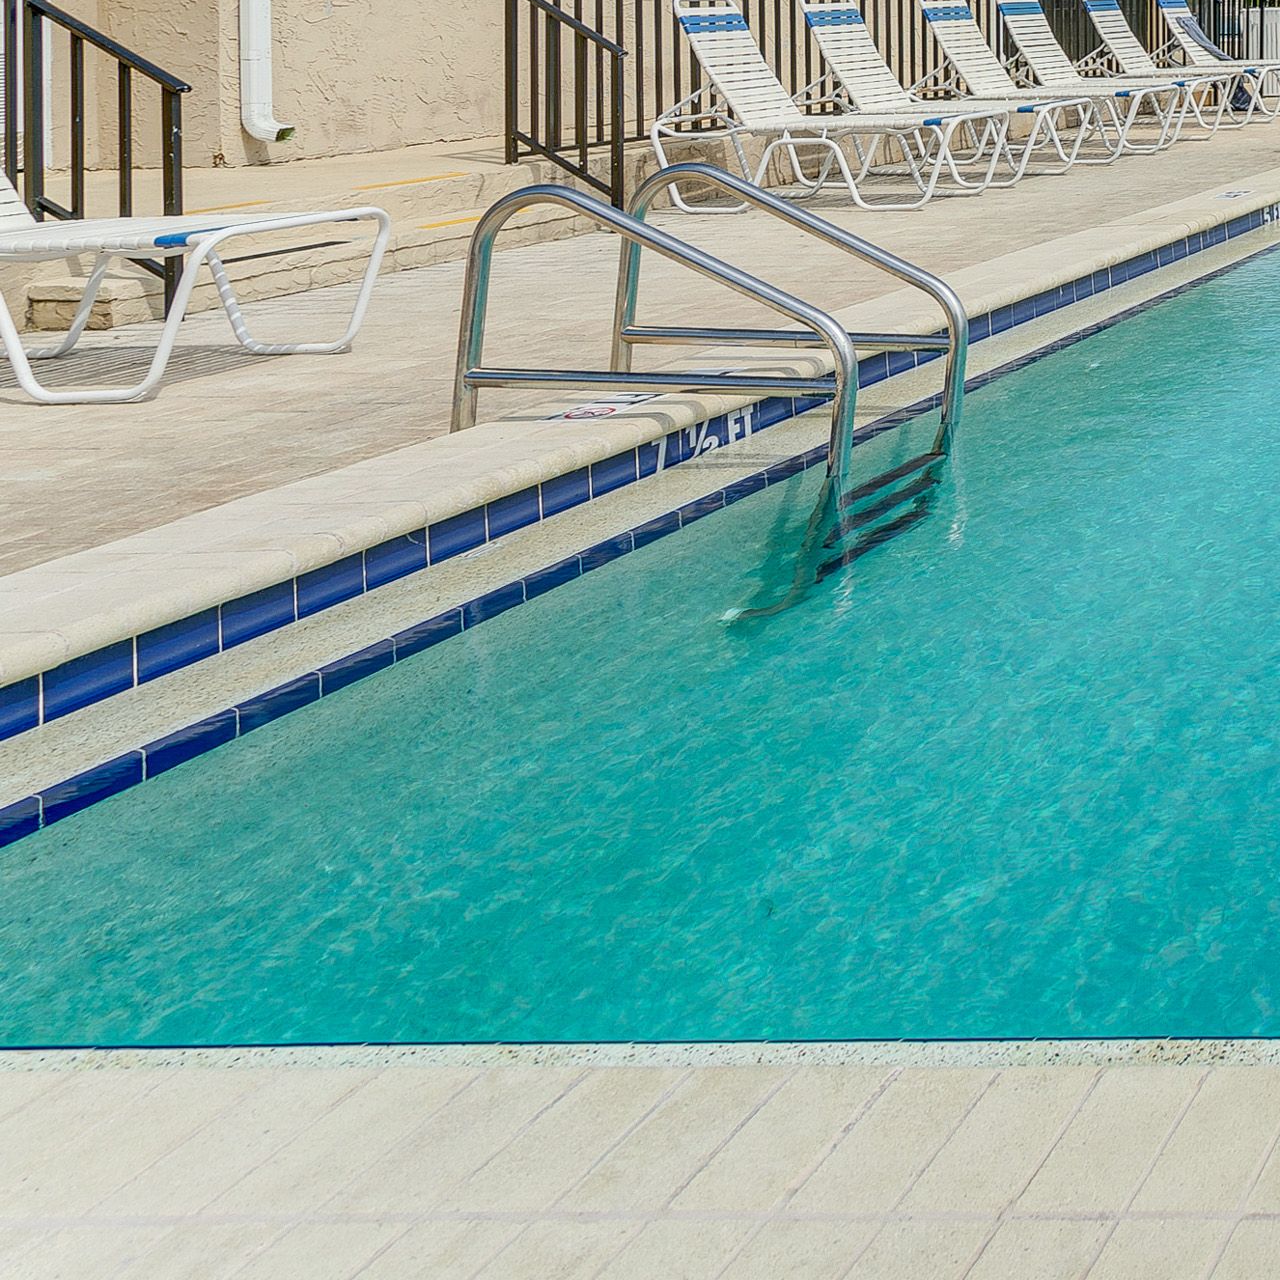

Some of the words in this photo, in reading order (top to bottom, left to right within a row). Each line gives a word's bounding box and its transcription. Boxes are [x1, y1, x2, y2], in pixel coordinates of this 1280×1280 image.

[1263, 206, 1271, 225] 5
[651, 436, 669, 470] 7
[728, 404, 754, 444] FT
